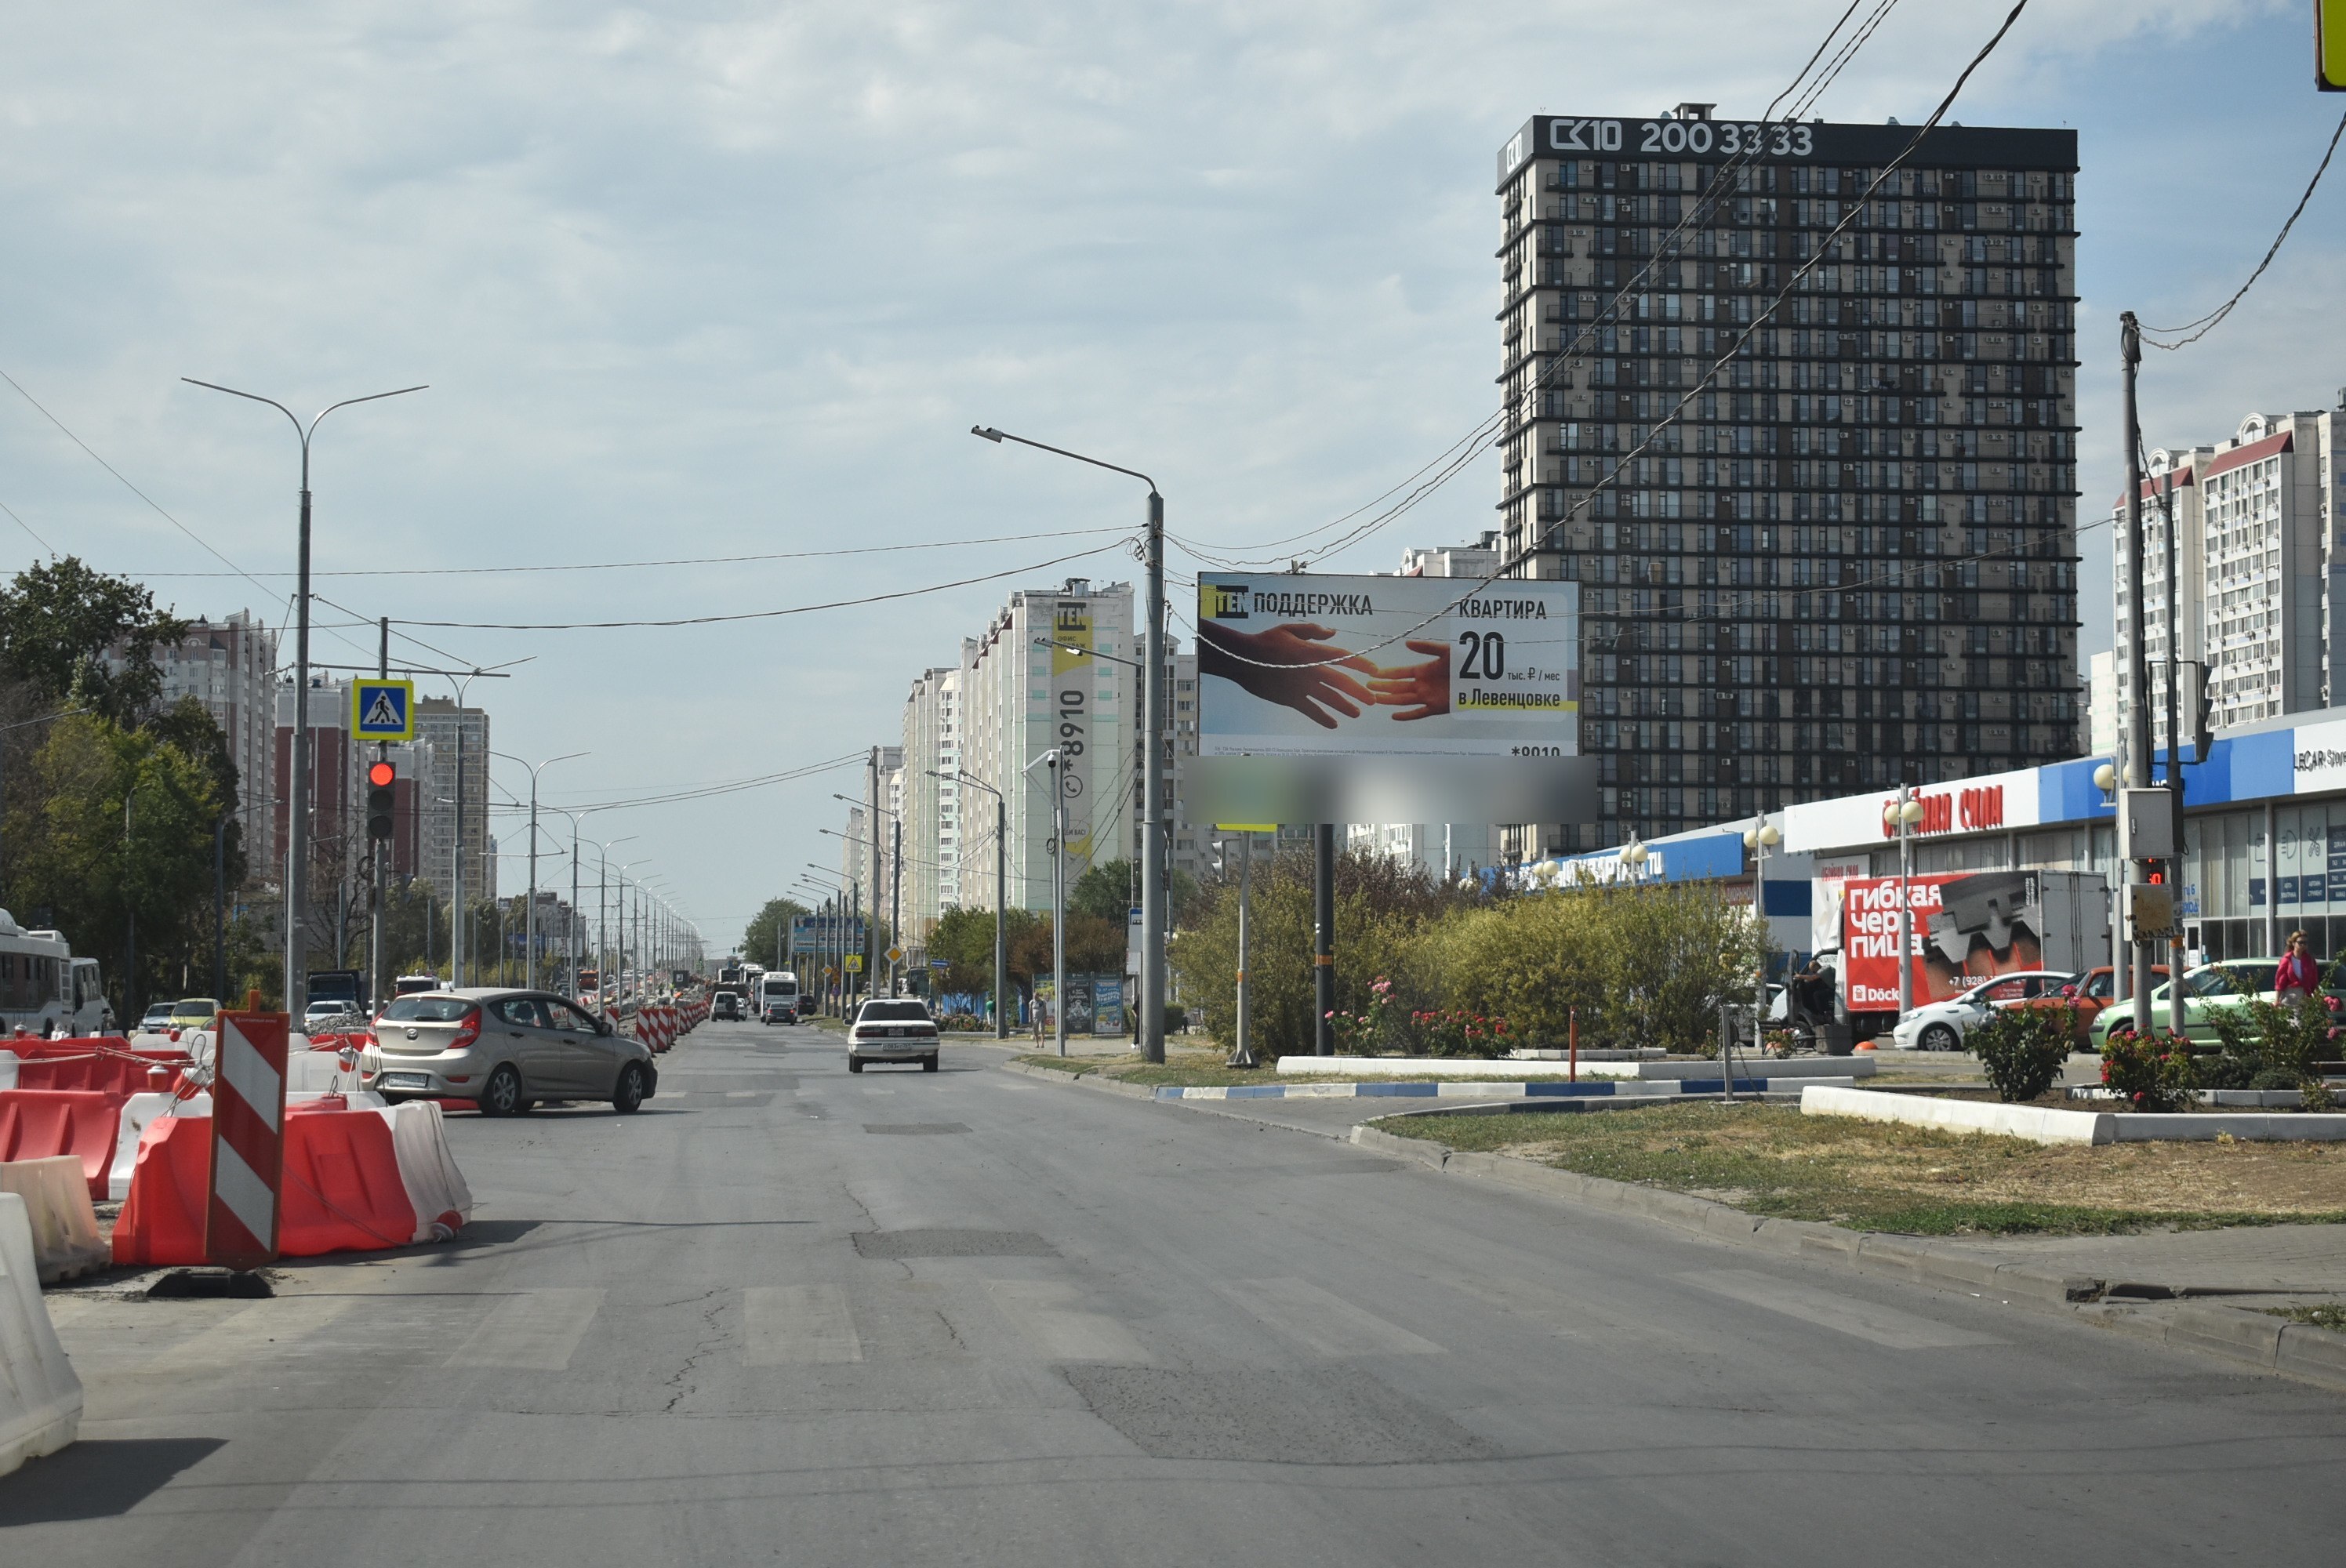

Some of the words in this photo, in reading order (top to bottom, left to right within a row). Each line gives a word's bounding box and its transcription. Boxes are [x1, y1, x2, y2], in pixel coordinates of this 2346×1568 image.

[1640, 122, 1712, 153] 200
[1719, 124, 1763, 154] 33
[1770, 125, 1813, 156] 33
[1255, 593, 1373, 617] ПОДДЕРЖКА
[1459, 599, 1546, 619] КВАРТИРА
[1459, 631, 1504, 680] 20
[1508, 672, 1526, 681] тыс.
[1458, 692, 1466, 705] в
[1470, 688, 1560, 709] Левенцовке
[1850, 880, 1944, 911] гибкая
[1948, 976, 1959, 986] +7
